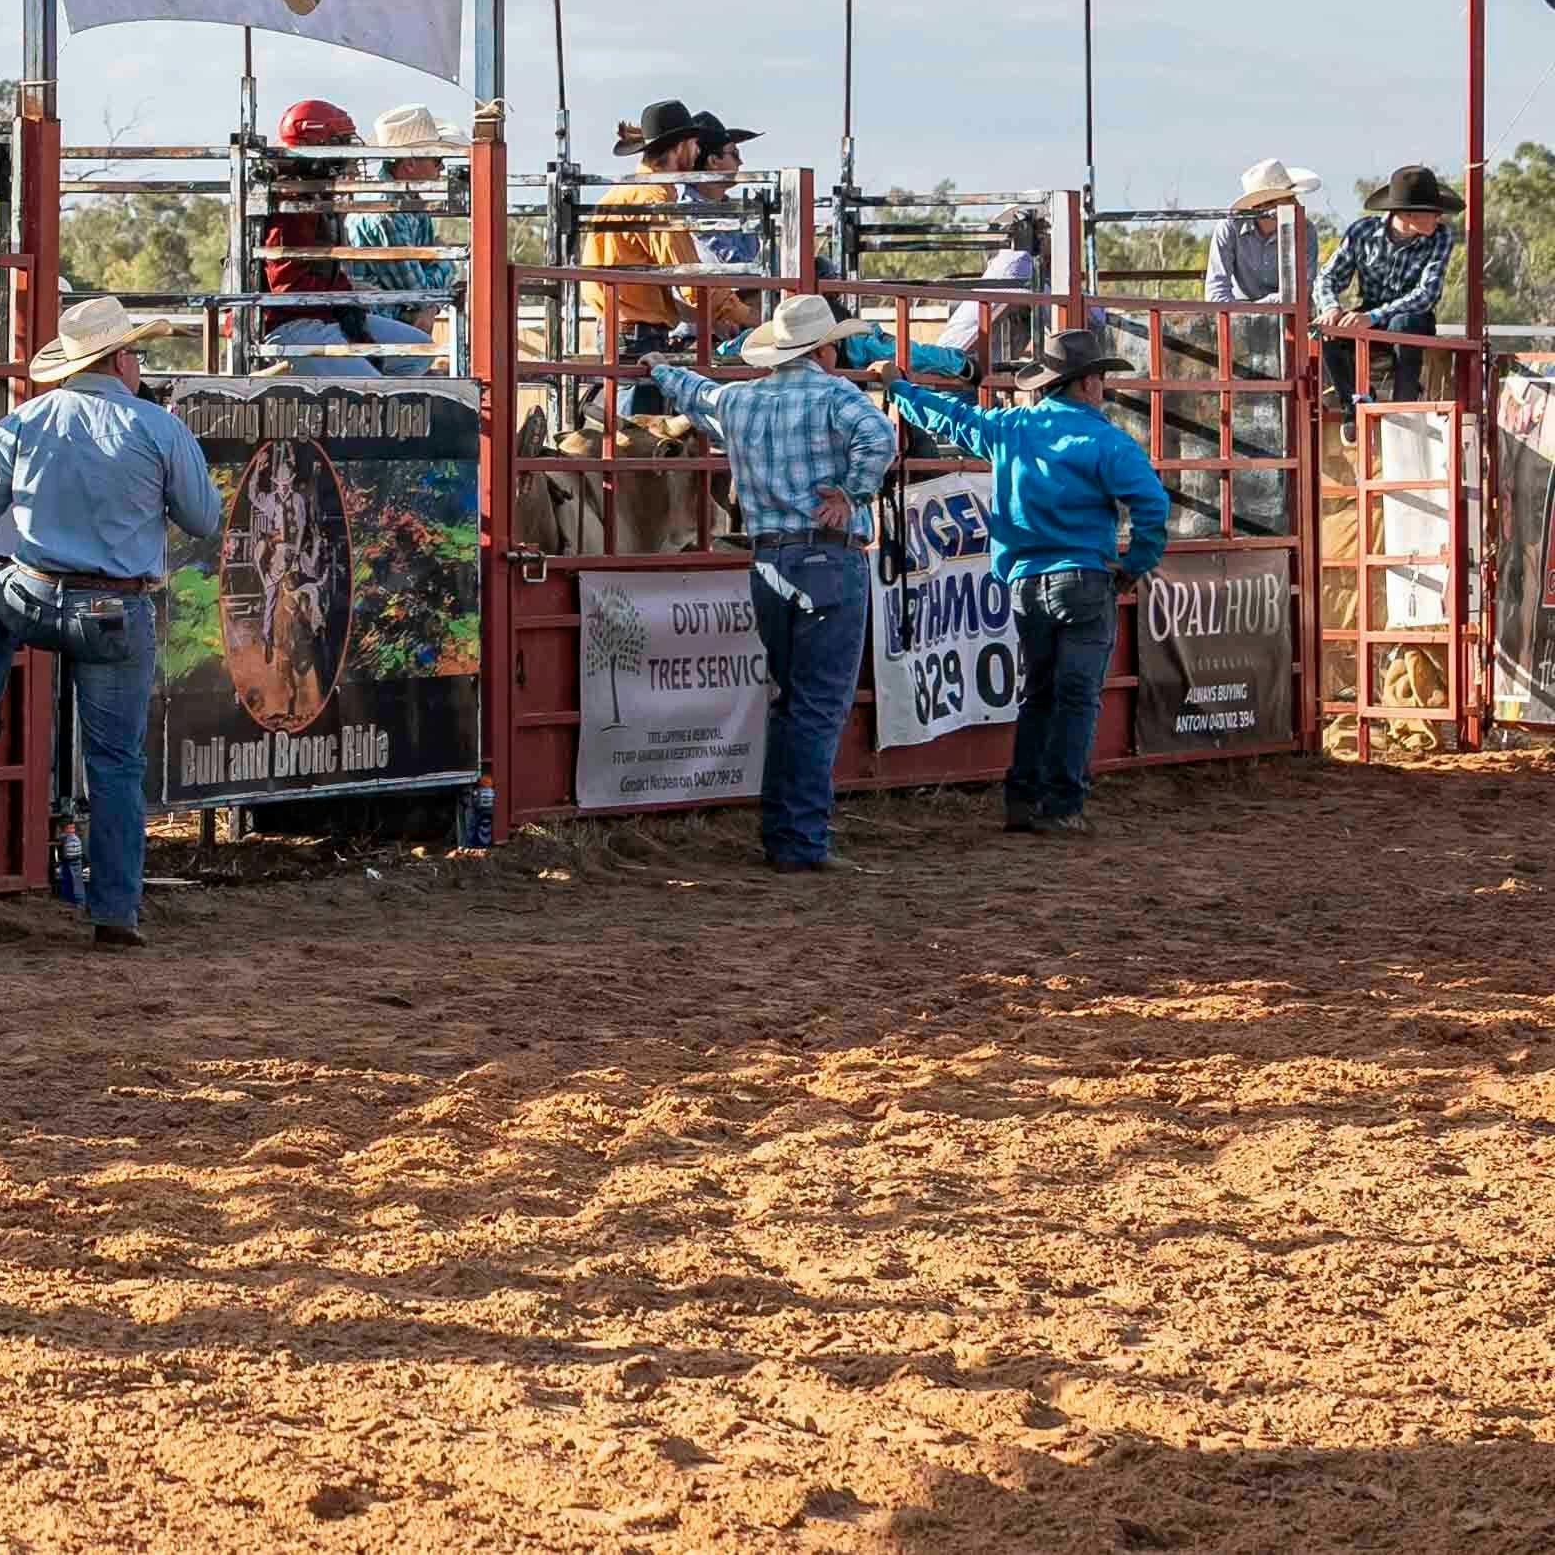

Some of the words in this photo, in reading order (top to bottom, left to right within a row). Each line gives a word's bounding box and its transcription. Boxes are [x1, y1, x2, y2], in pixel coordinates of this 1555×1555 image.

[264, 397, 324, 443] Ridge
[327, 397, 382, 438] Black
[648, 657, 692, 691] TREE
[1218, 682, 1248, 701] BUYING
[1175, 713, 1208, 733] ANTON
[181, 735, 225, 787] Bull
[229, 732, 269, 782] and
[274, 731, 338, 778] Bronc
[341, 724, 389, 771] Ride
